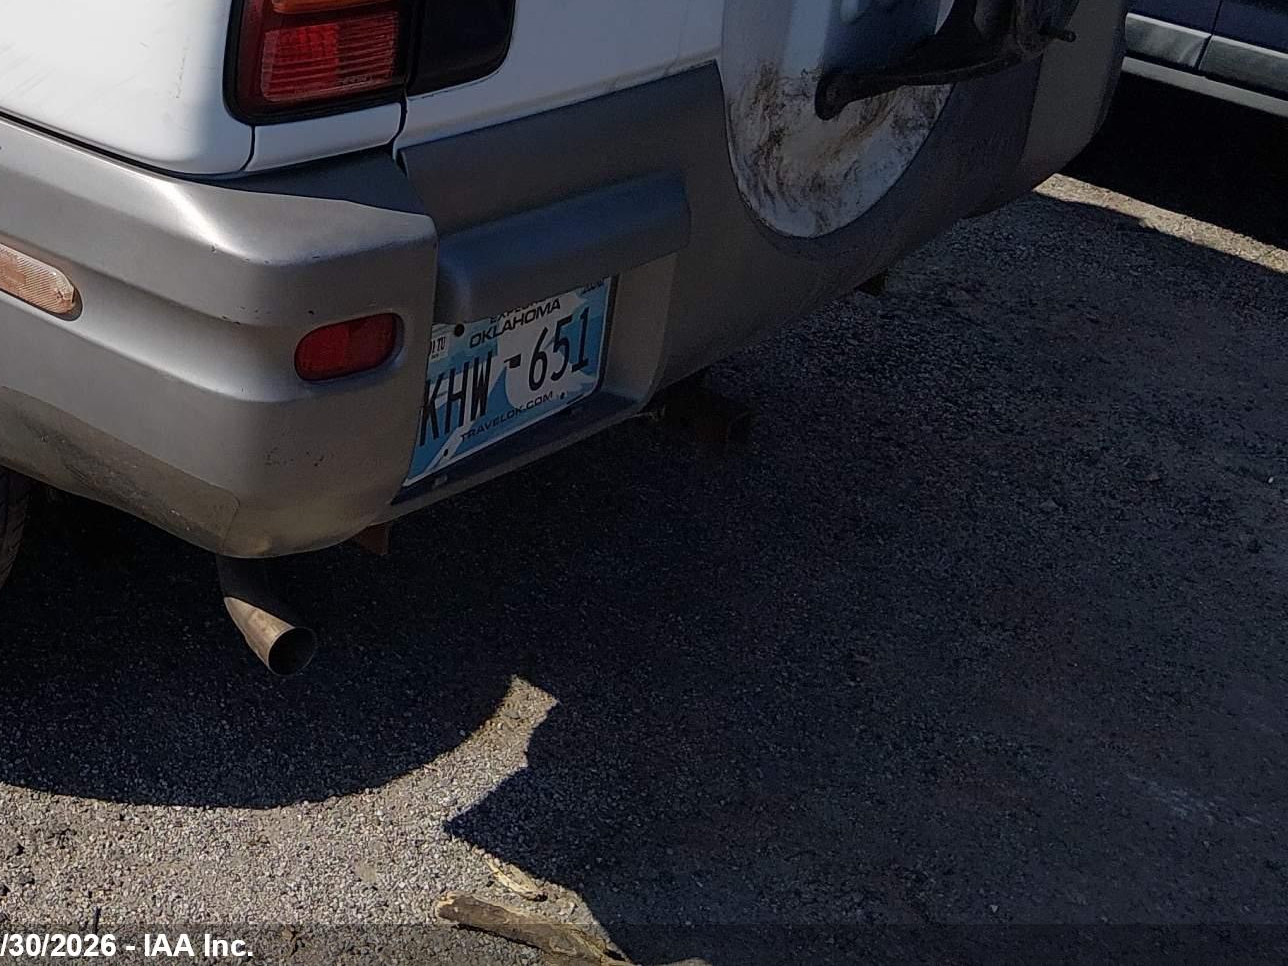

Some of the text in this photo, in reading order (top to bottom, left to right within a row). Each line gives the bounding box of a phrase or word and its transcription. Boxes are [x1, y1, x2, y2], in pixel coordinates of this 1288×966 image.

[469, 298, 561, 349] OKLAHOMA
[419, 306, 590, 447] KHW 651
[460, 390, 553, 442] TRAVELOK.COM
